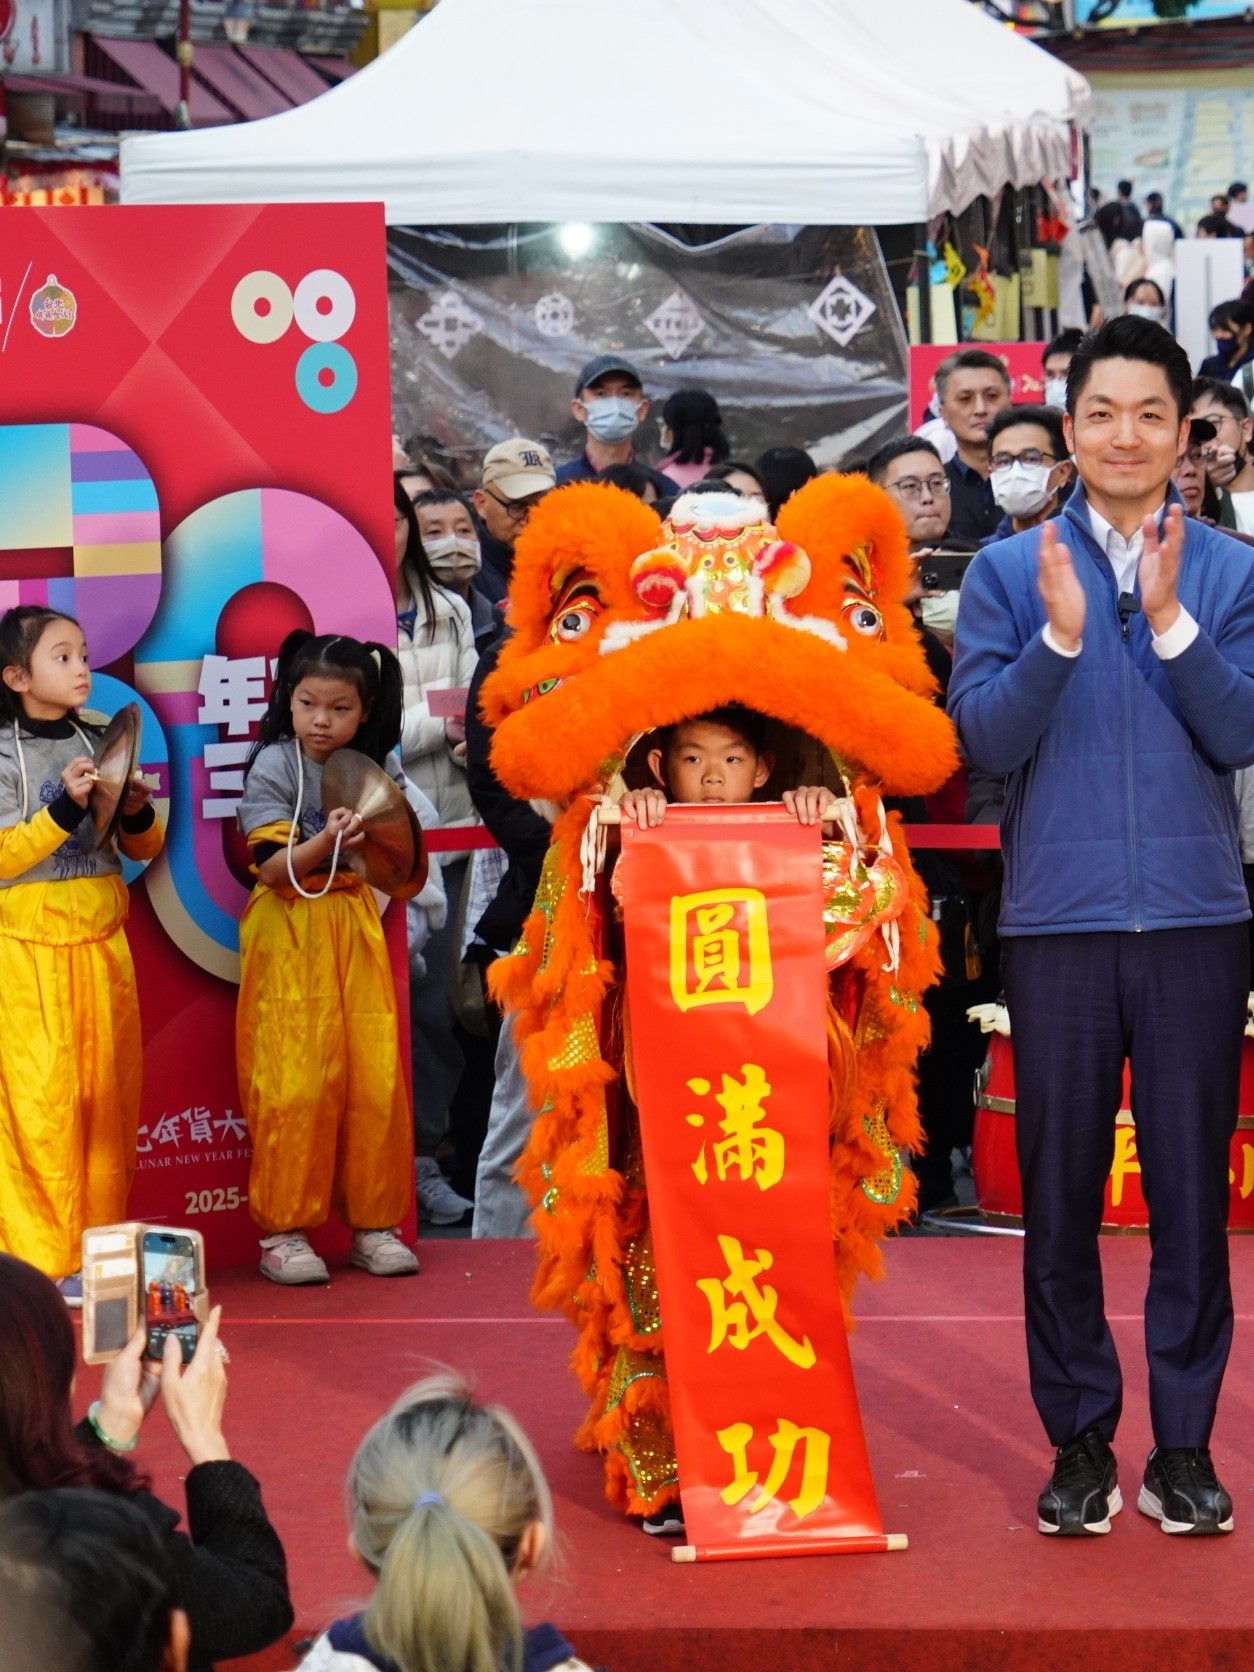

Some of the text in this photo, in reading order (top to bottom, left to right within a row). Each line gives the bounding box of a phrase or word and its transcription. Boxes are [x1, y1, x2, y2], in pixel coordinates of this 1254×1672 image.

[198, 654, 279, 736] 年
[137, 1156, 172, 1170] UNAR
[174, 1153, 200, 1166] NEW
[204, 1150, 233, 1163] YEAR
[185, 1186, 248, 1215] 2025-
[668, 888, 833, 1521] 圓滿成功
